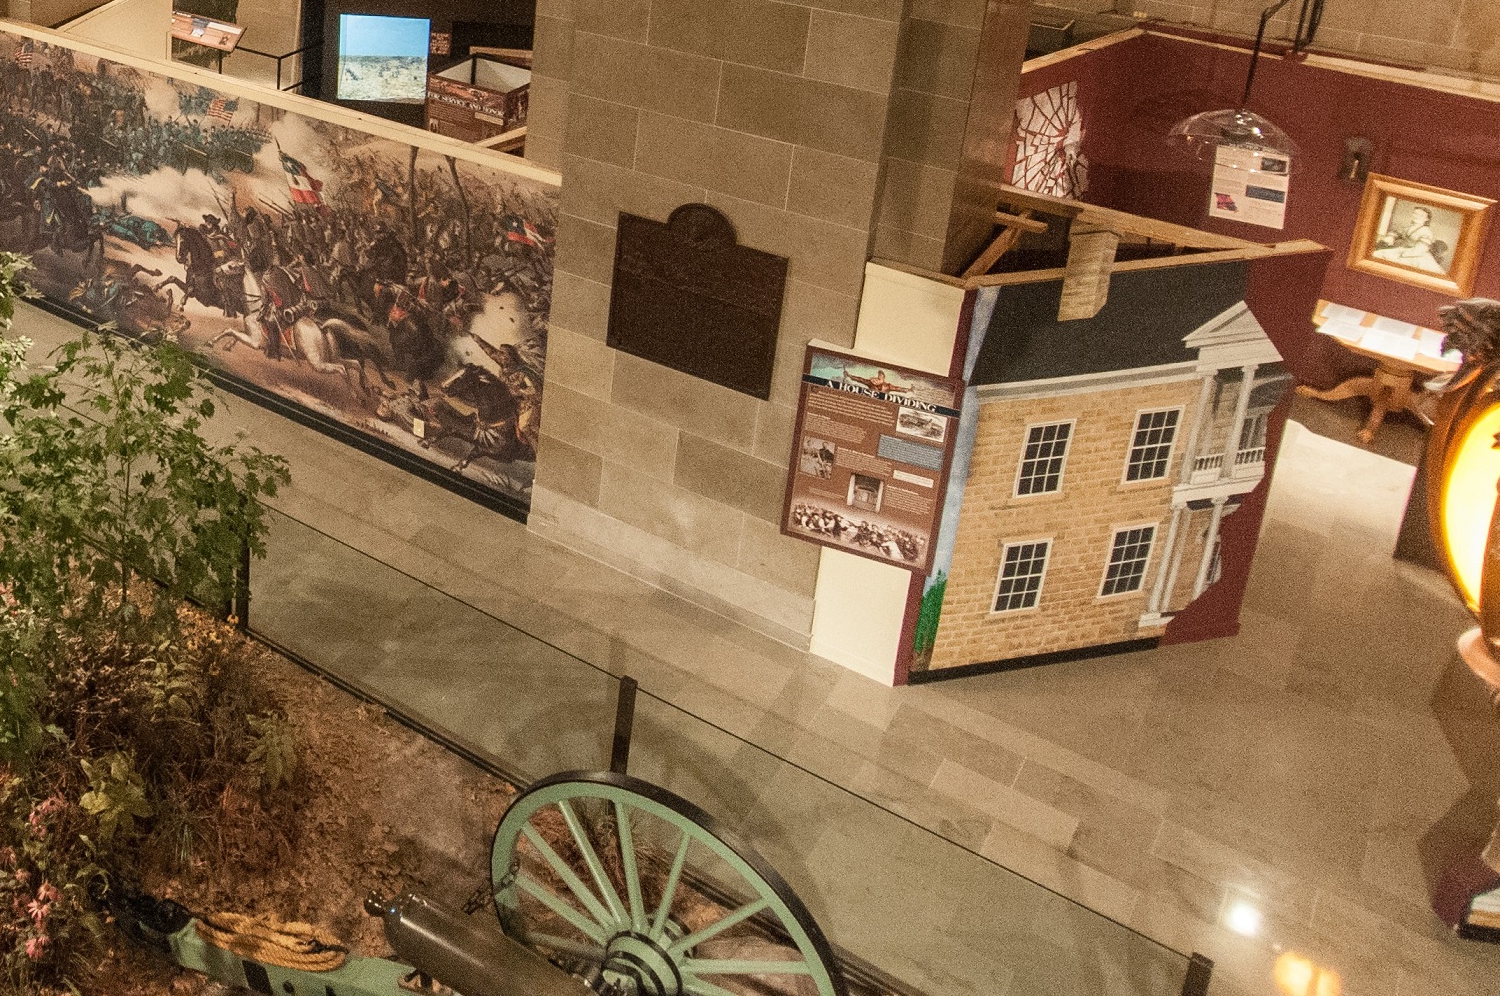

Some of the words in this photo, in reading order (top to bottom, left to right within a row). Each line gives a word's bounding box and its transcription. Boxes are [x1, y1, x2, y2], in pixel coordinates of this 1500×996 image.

[825, 380, 835, 390] A
[839, 381, 881, 400] HOUSE
[884, 393, 937, 413] DIVIDING
